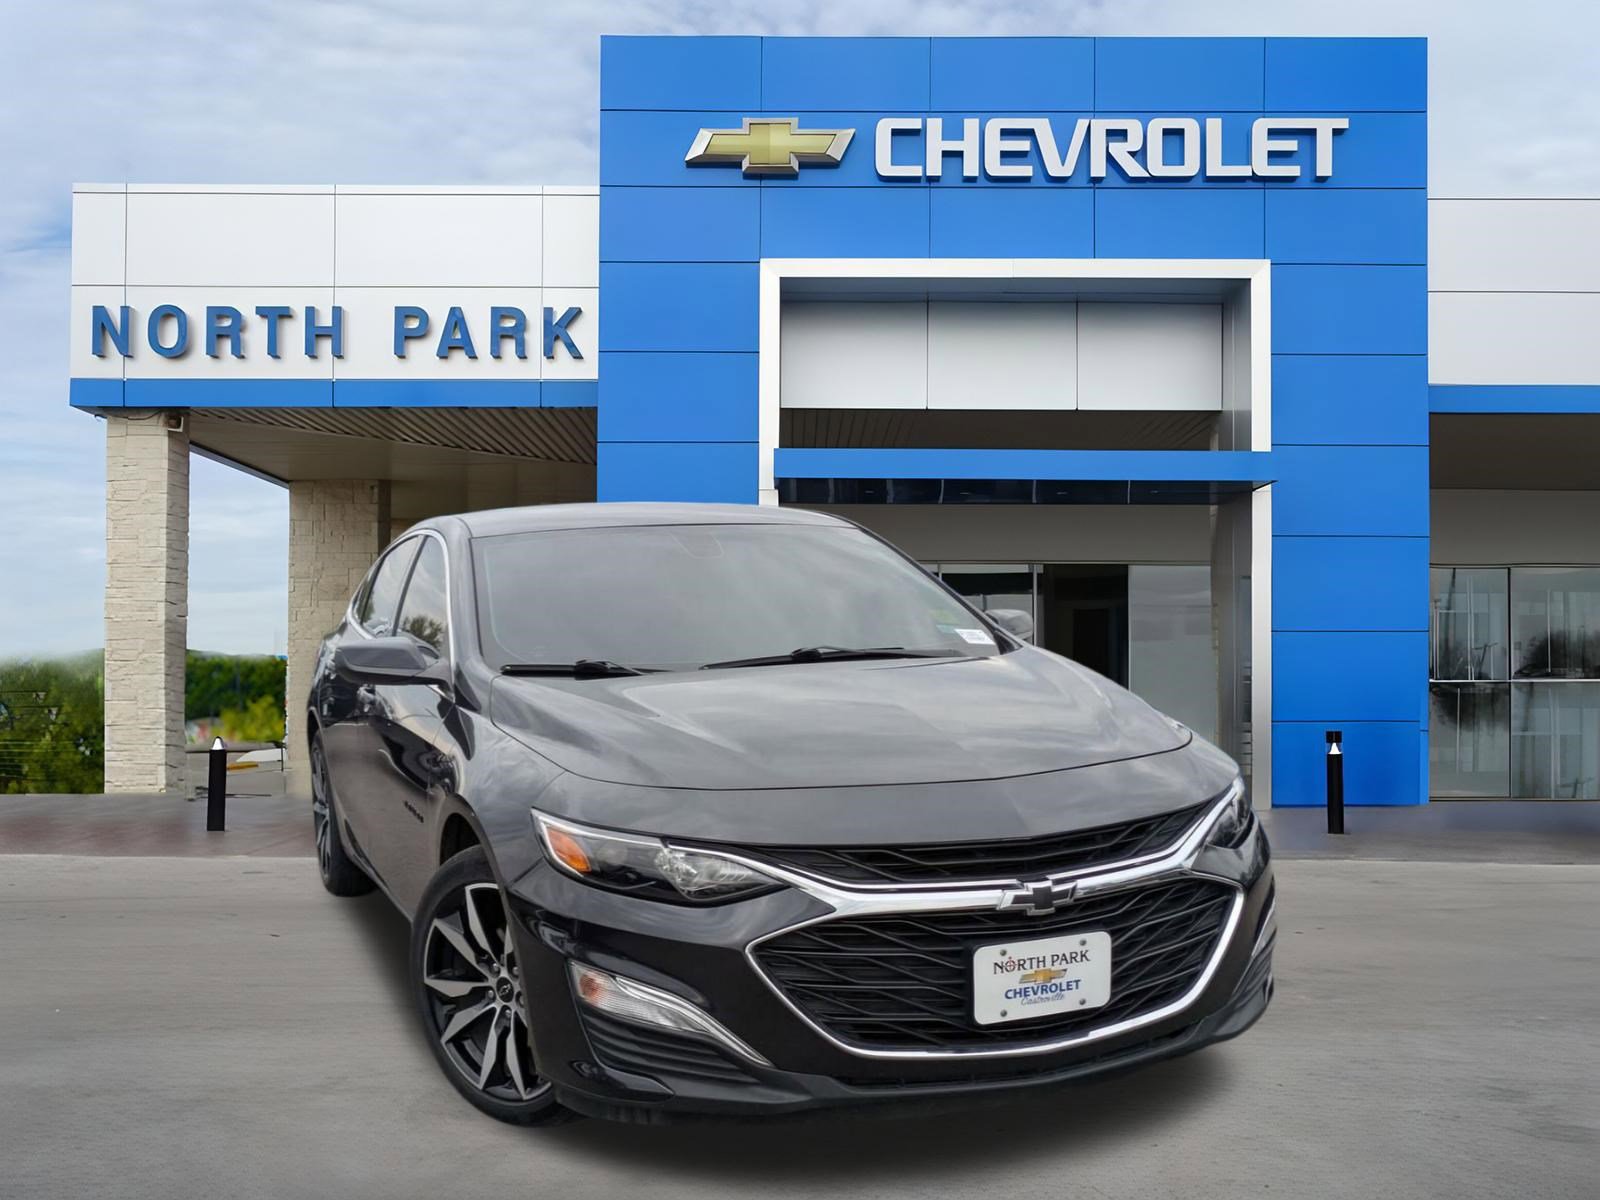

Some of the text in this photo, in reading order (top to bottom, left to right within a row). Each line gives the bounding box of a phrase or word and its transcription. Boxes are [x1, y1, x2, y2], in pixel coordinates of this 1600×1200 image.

[875, 117, 1350, 181] CHEVROLET
[92, 304, 584, 360] NORTH PARK
[993, 950, 1091, 974] NORTH PARK
[1004, 979, 1082, 1000] CHEVROLET
